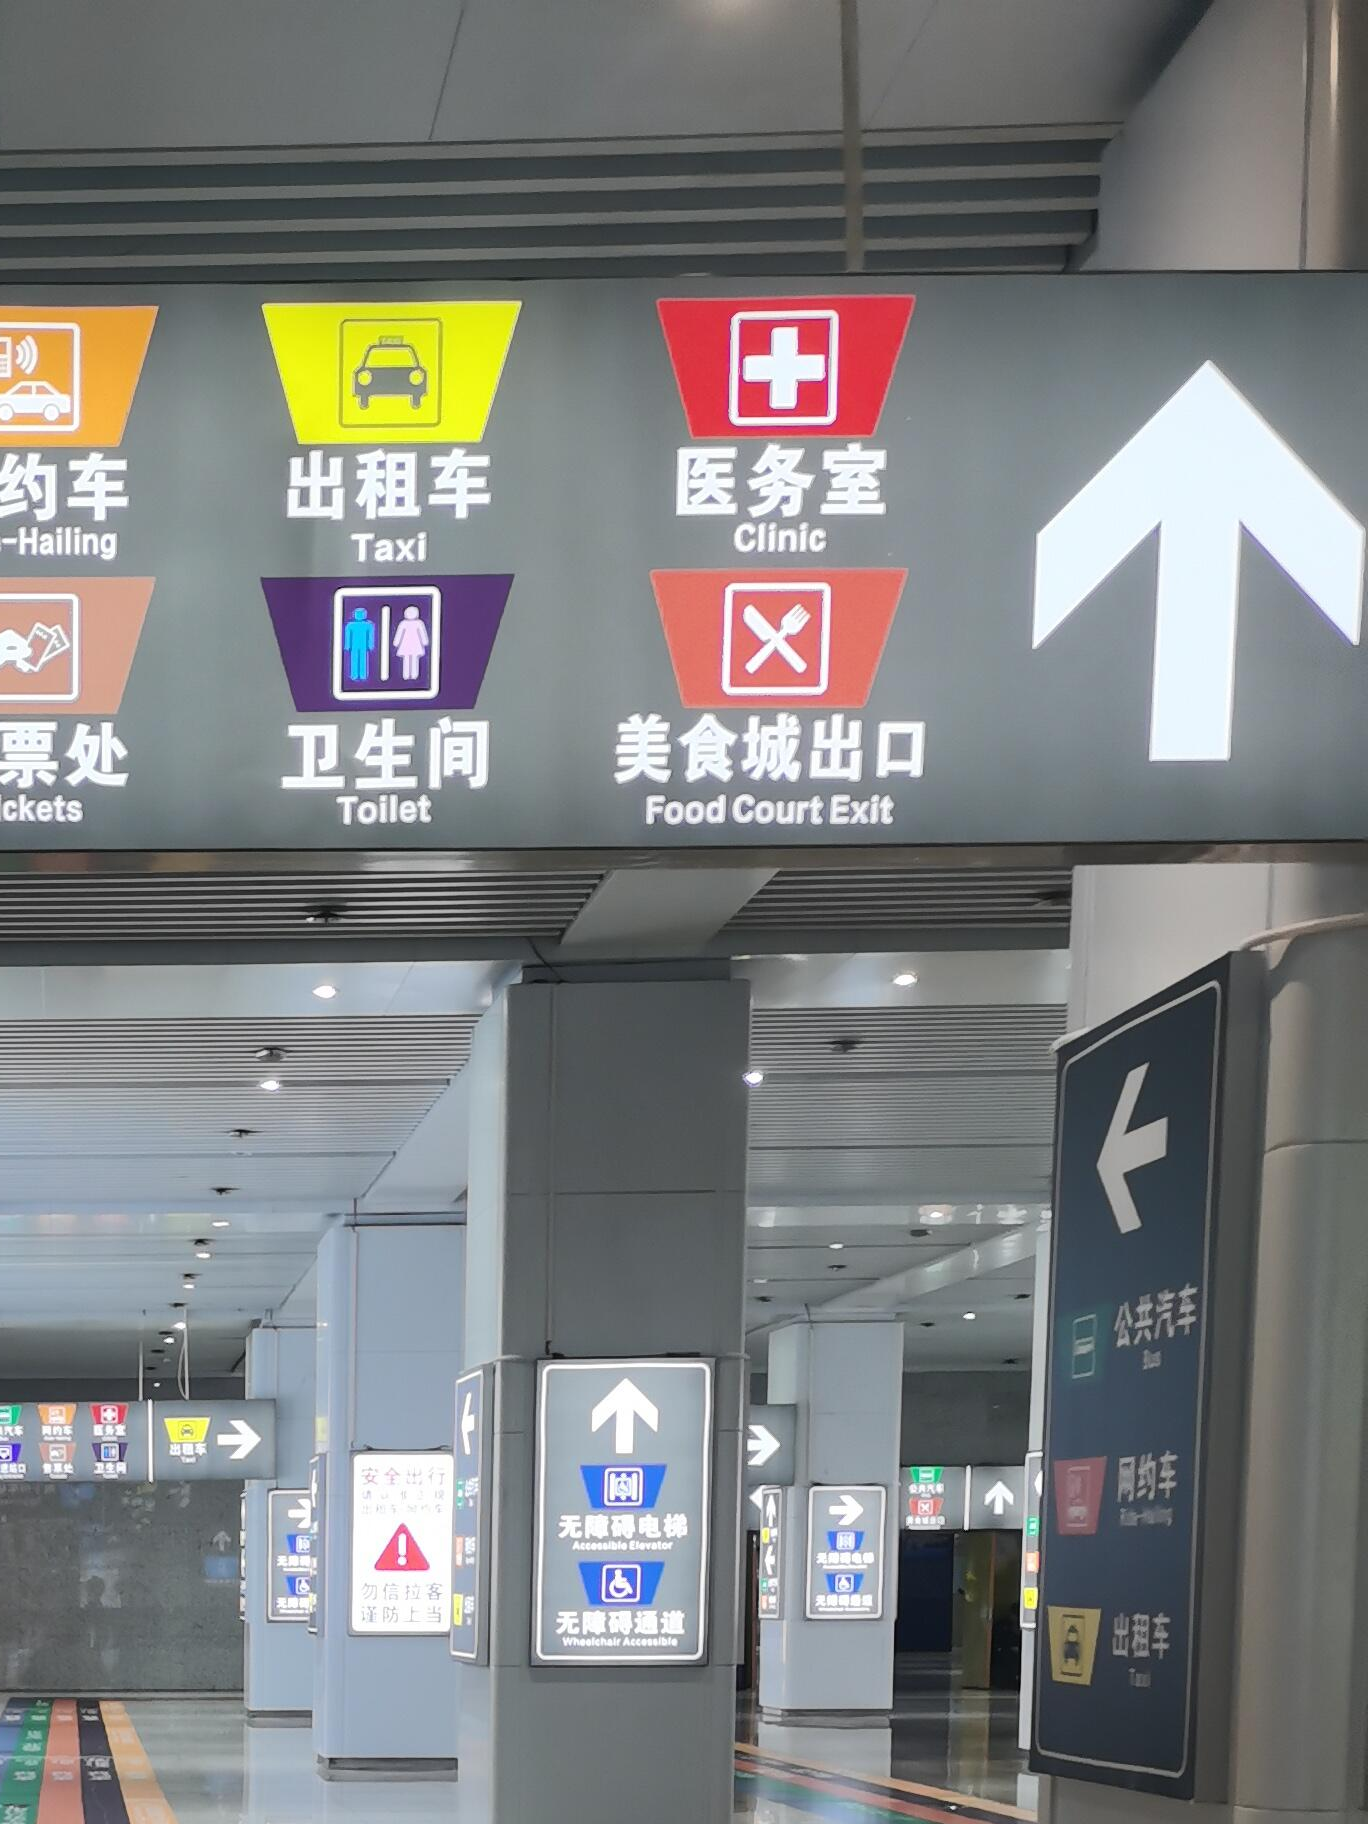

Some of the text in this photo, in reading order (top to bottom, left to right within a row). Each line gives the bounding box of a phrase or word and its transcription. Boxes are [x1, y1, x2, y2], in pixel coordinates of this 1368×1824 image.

[285, 447, 493, 522] 出租车
[674, 442, 889, 518] 医务室
[349, 531, 428, 564] Taxi
[732, 521, 828, 555] Clinic
[279, 716, 490, 791] 卫生间
[613, 713, 927, 785] 美食城出口
[335, 793, 432, 826] Toilet
[645, 793, 895, 826] Food Court Exit
[1114, 1283, 1198, 1348] 公共汽车
[1117, 1450, 1179, 1503] 网约车
[557, 1513, 689, 1540] 无障碍电梯
[361, 1582, 444, 1602] 勿信拉客
[361, 1606, 443, 1624] 谨防上当
[555, 1610, 686, 1636] 无障碍通道
[1112, 1612, 1171, 1661] 出租车
